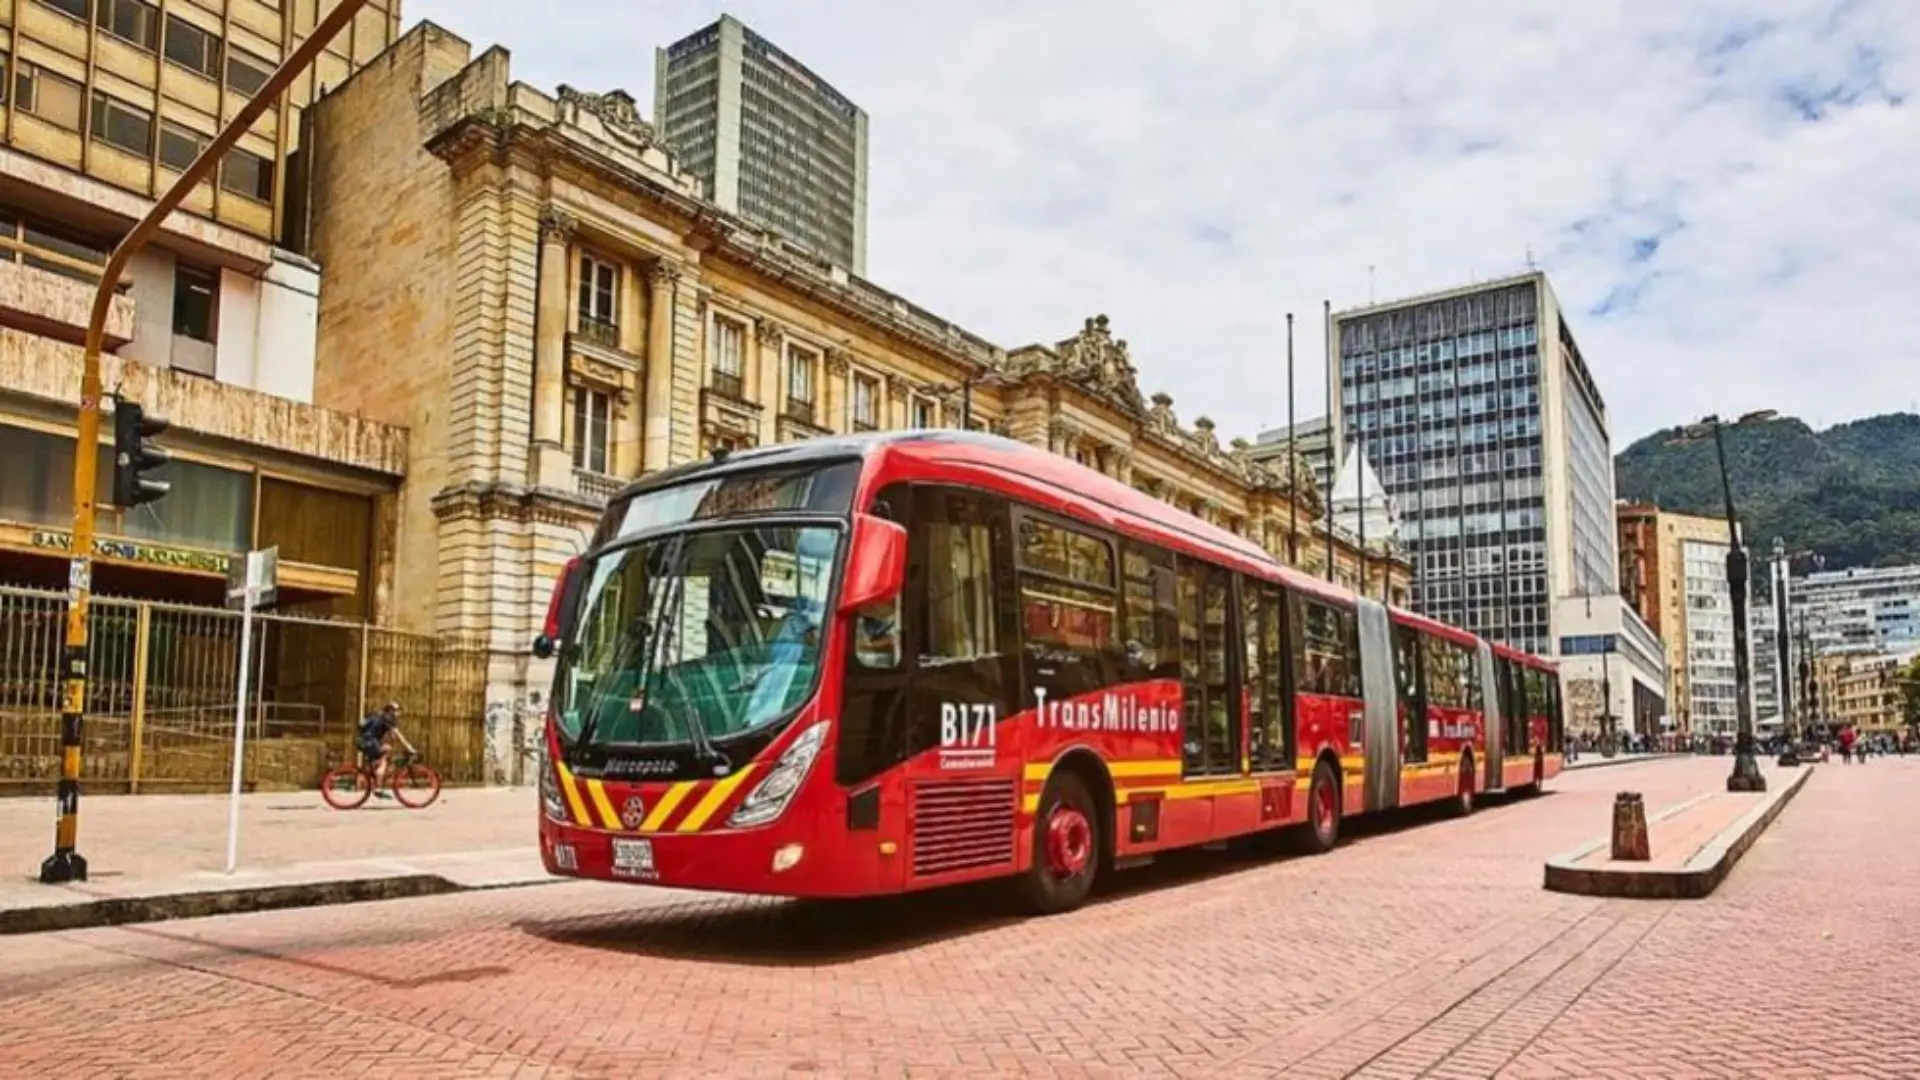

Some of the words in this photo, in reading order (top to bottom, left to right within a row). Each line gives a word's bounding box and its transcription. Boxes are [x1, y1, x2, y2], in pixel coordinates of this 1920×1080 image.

[32, 531, 99, 553] BAN
[941, 702, 996, 747] B171
[1034, 687, 1179, 732] TransMilenio
